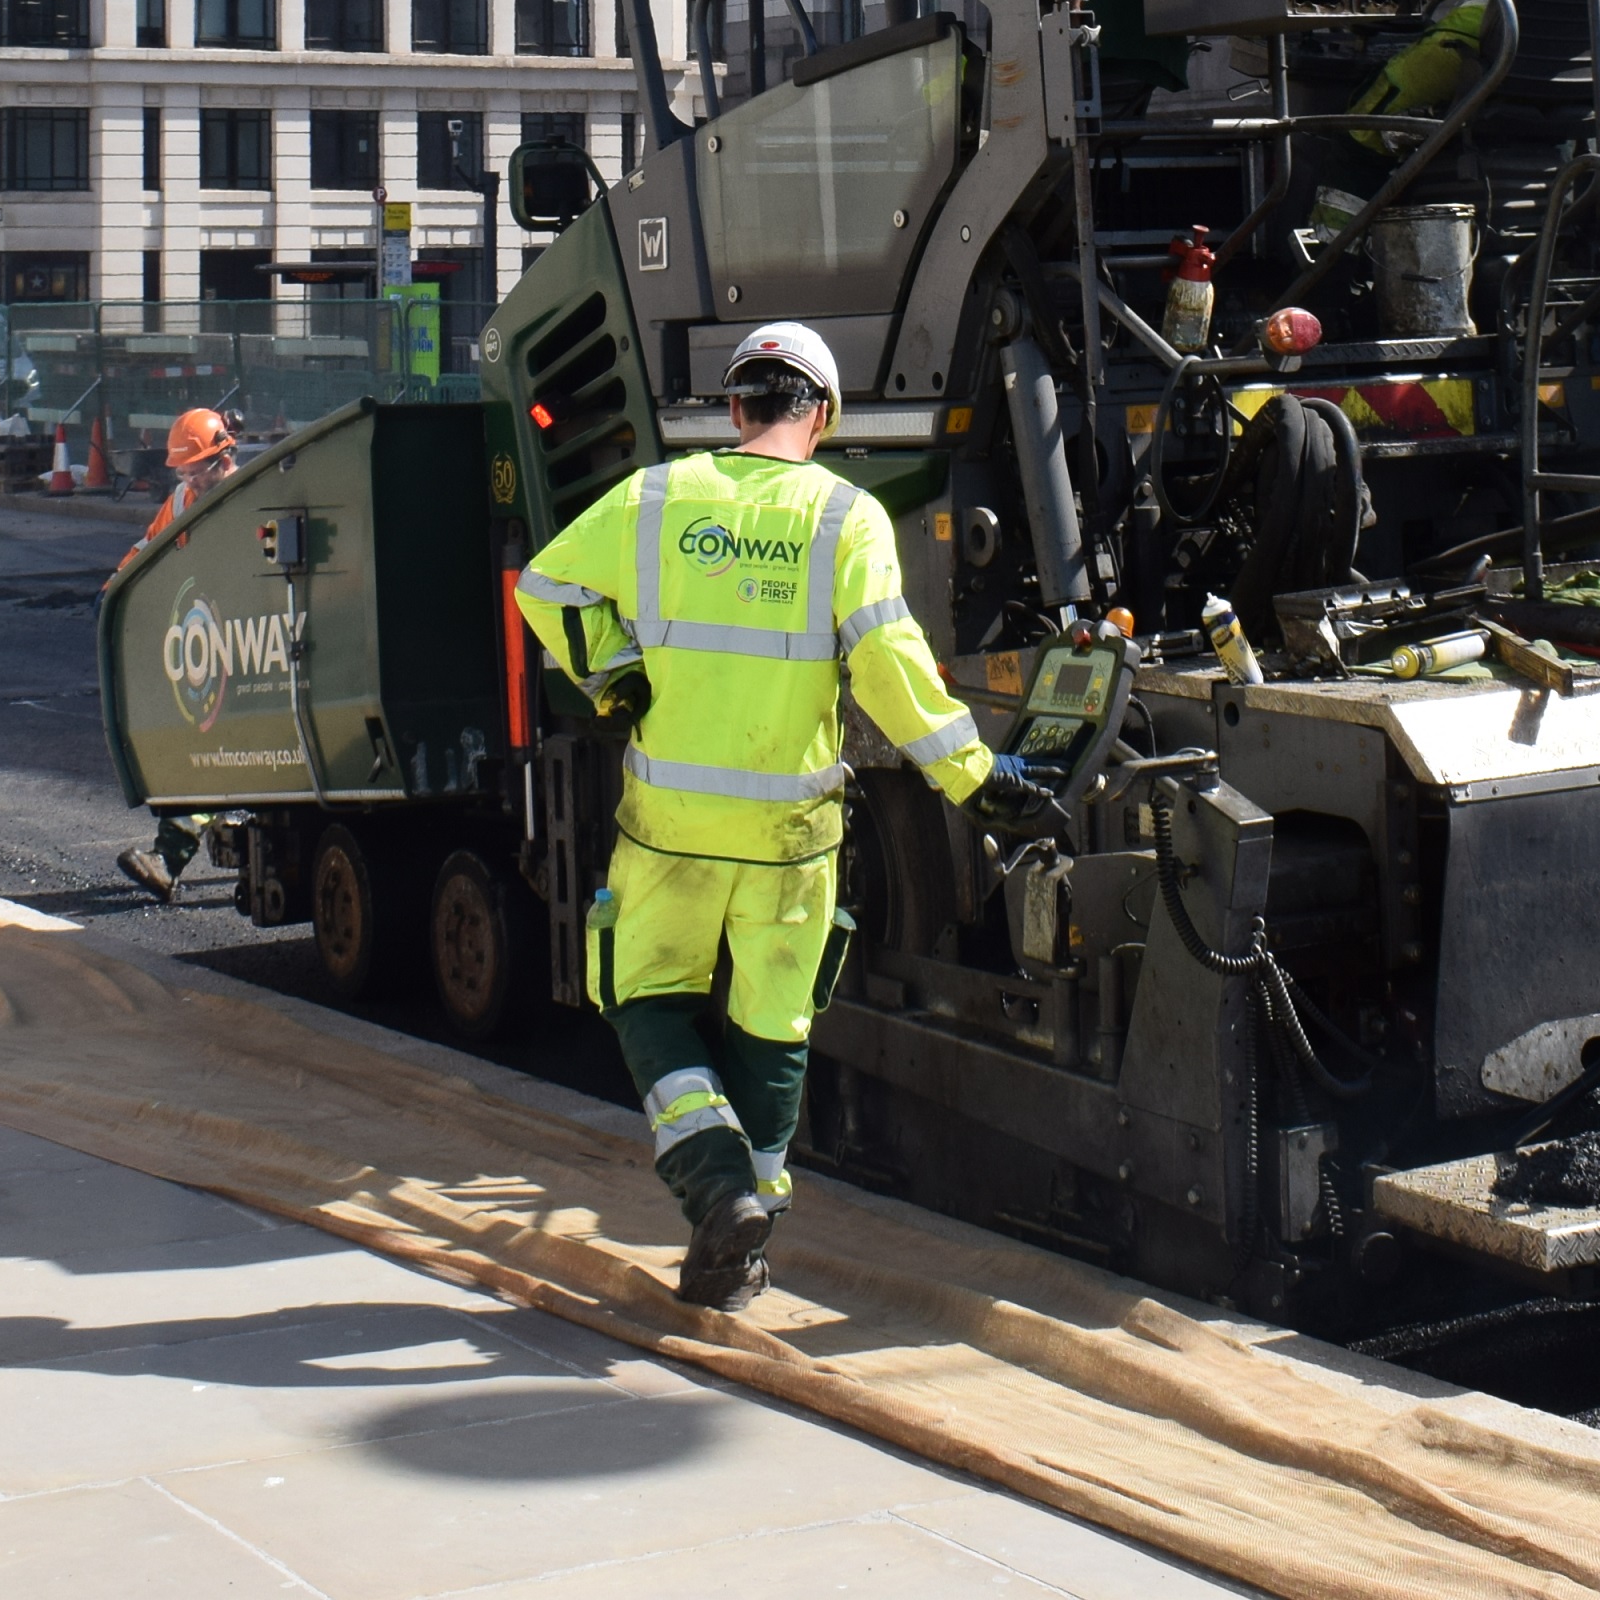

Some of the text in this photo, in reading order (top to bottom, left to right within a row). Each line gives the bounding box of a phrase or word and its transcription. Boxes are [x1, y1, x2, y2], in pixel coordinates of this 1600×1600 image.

[495, 461, 512, 488] 50
[679, 530, 804, 564] CONWAY
[761, 588, 798, 601] FIRST
[762, 580, 798, 590] PEOPLE
